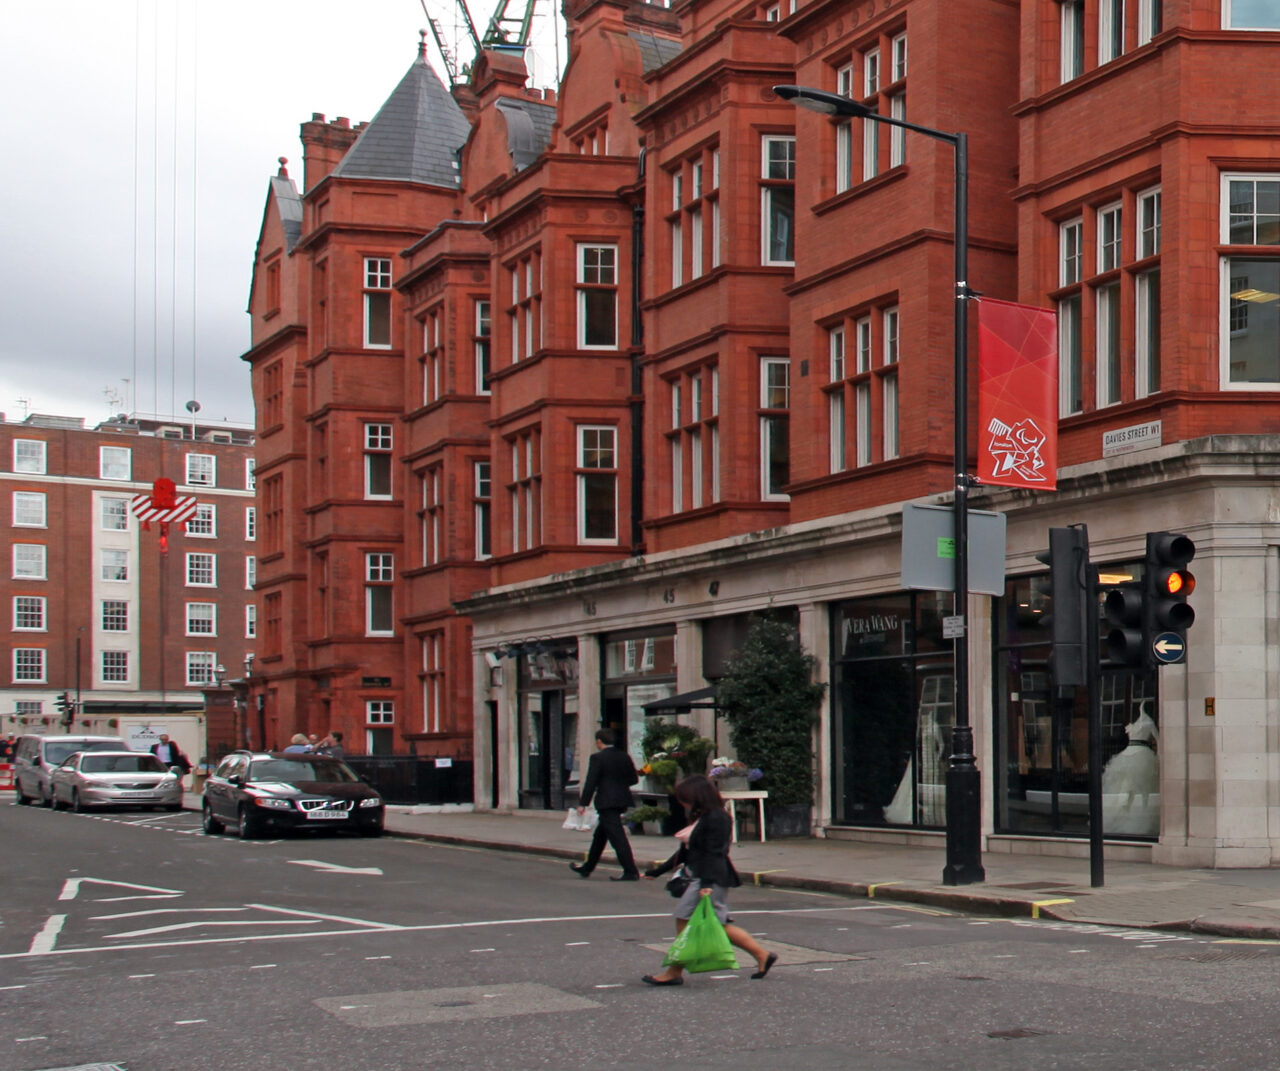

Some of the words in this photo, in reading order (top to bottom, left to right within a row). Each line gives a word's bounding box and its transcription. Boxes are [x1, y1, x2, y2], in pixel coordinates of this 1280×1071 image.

[1105, 431, 1126, 445] DAVIES
[1127, 426, 1149, 439] STREET
[1150, 424, 1160, 435] W1
[663, 588, 675, 604] 45
[846, 617, 870, 633] VERA
[871, 614, 898, 631] WANG
